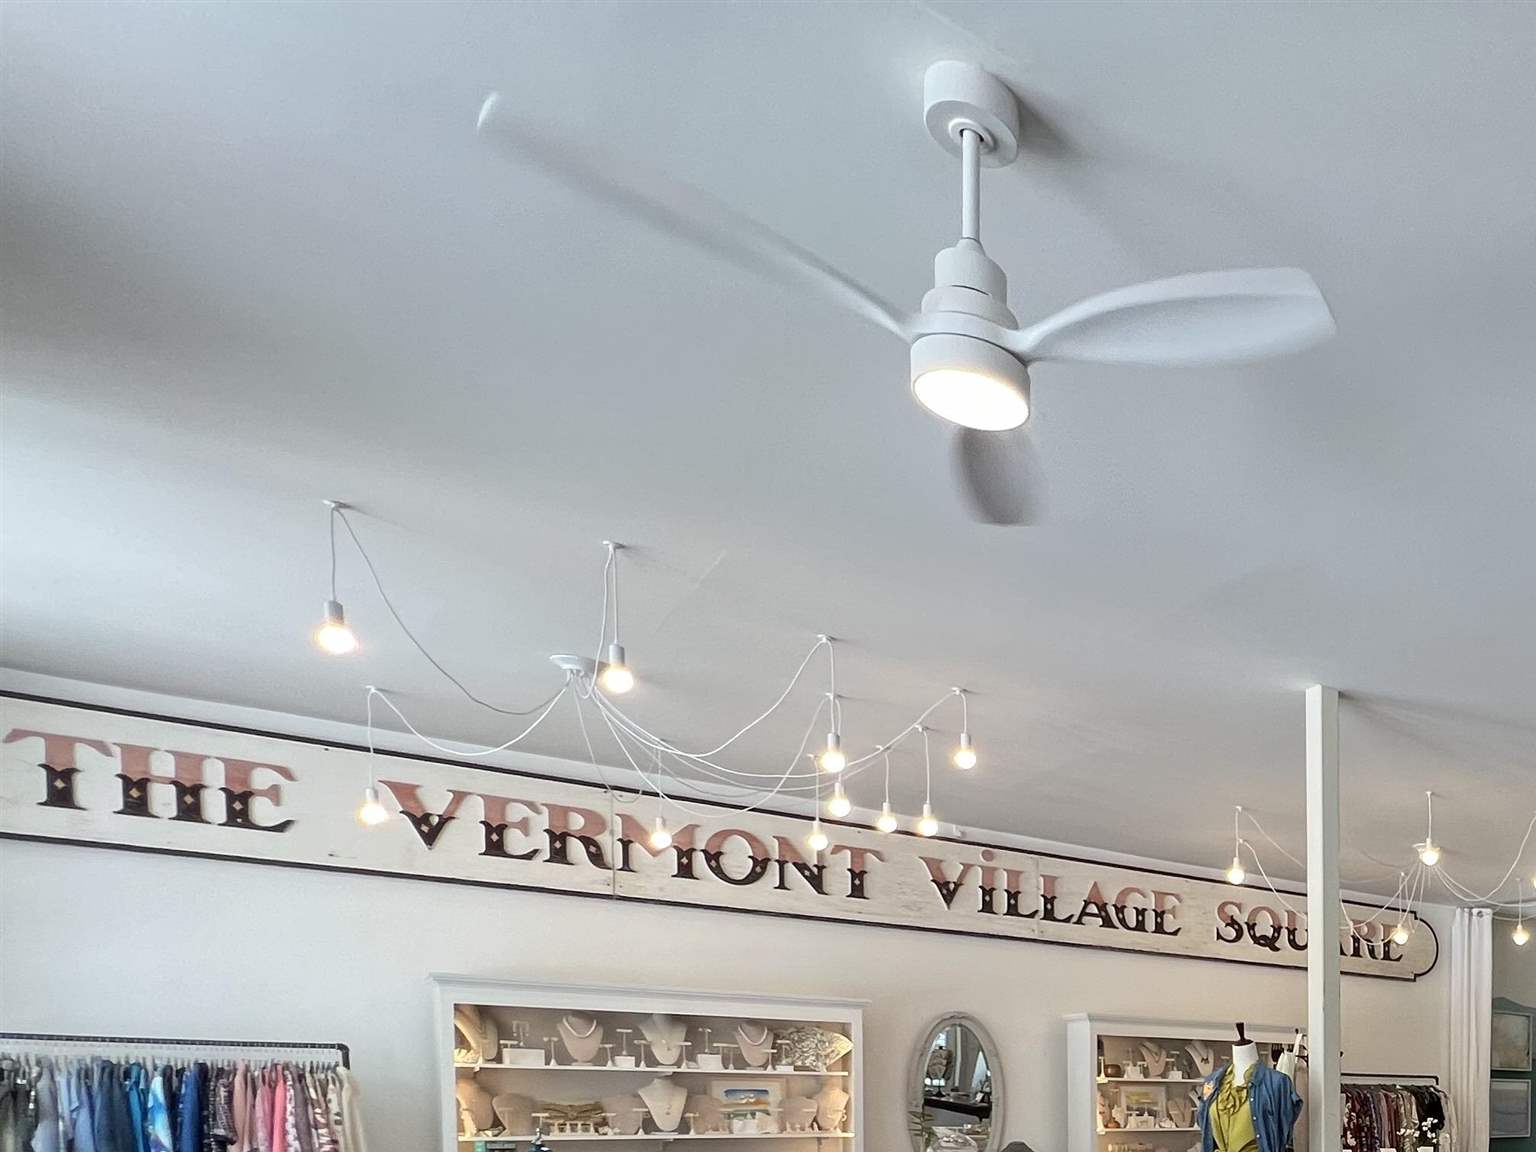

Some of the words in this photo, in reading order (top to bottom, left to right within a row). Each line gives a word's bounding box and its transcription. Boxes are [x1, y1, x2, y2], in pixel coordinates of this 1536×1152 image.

[3, 728, 298, 833] THE
[378, 779, 886, 900] VERMONT
[1216, 900, 1404, 962] SQURE
